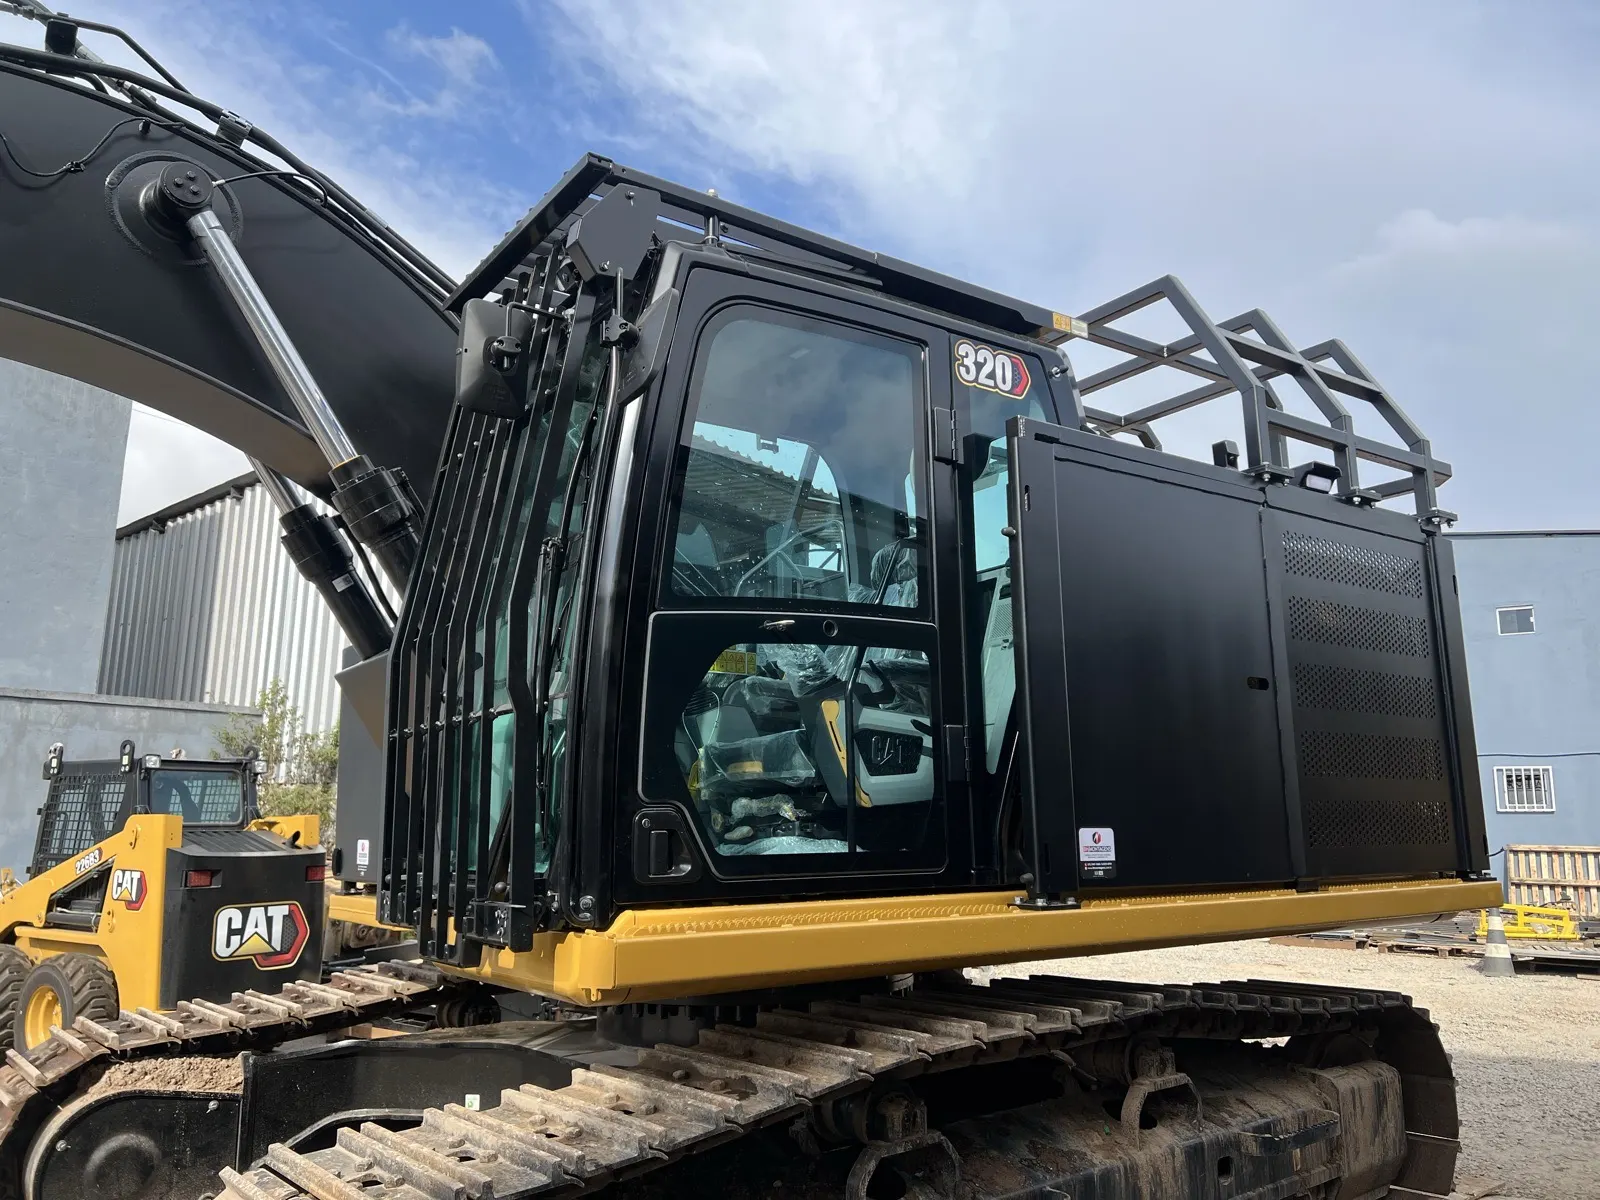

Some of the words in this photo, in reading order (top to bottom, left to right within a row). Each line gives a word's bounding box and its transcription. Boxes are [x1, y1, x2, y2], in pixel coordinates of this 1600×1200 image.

[958, 343, 1013, 391] 320
[871, 735, 904, 765] CAT
[75, 849, 100, 875] 226B3
[112, 869, 141, 901] CAT
[215, 904, 290, 958] CAT
